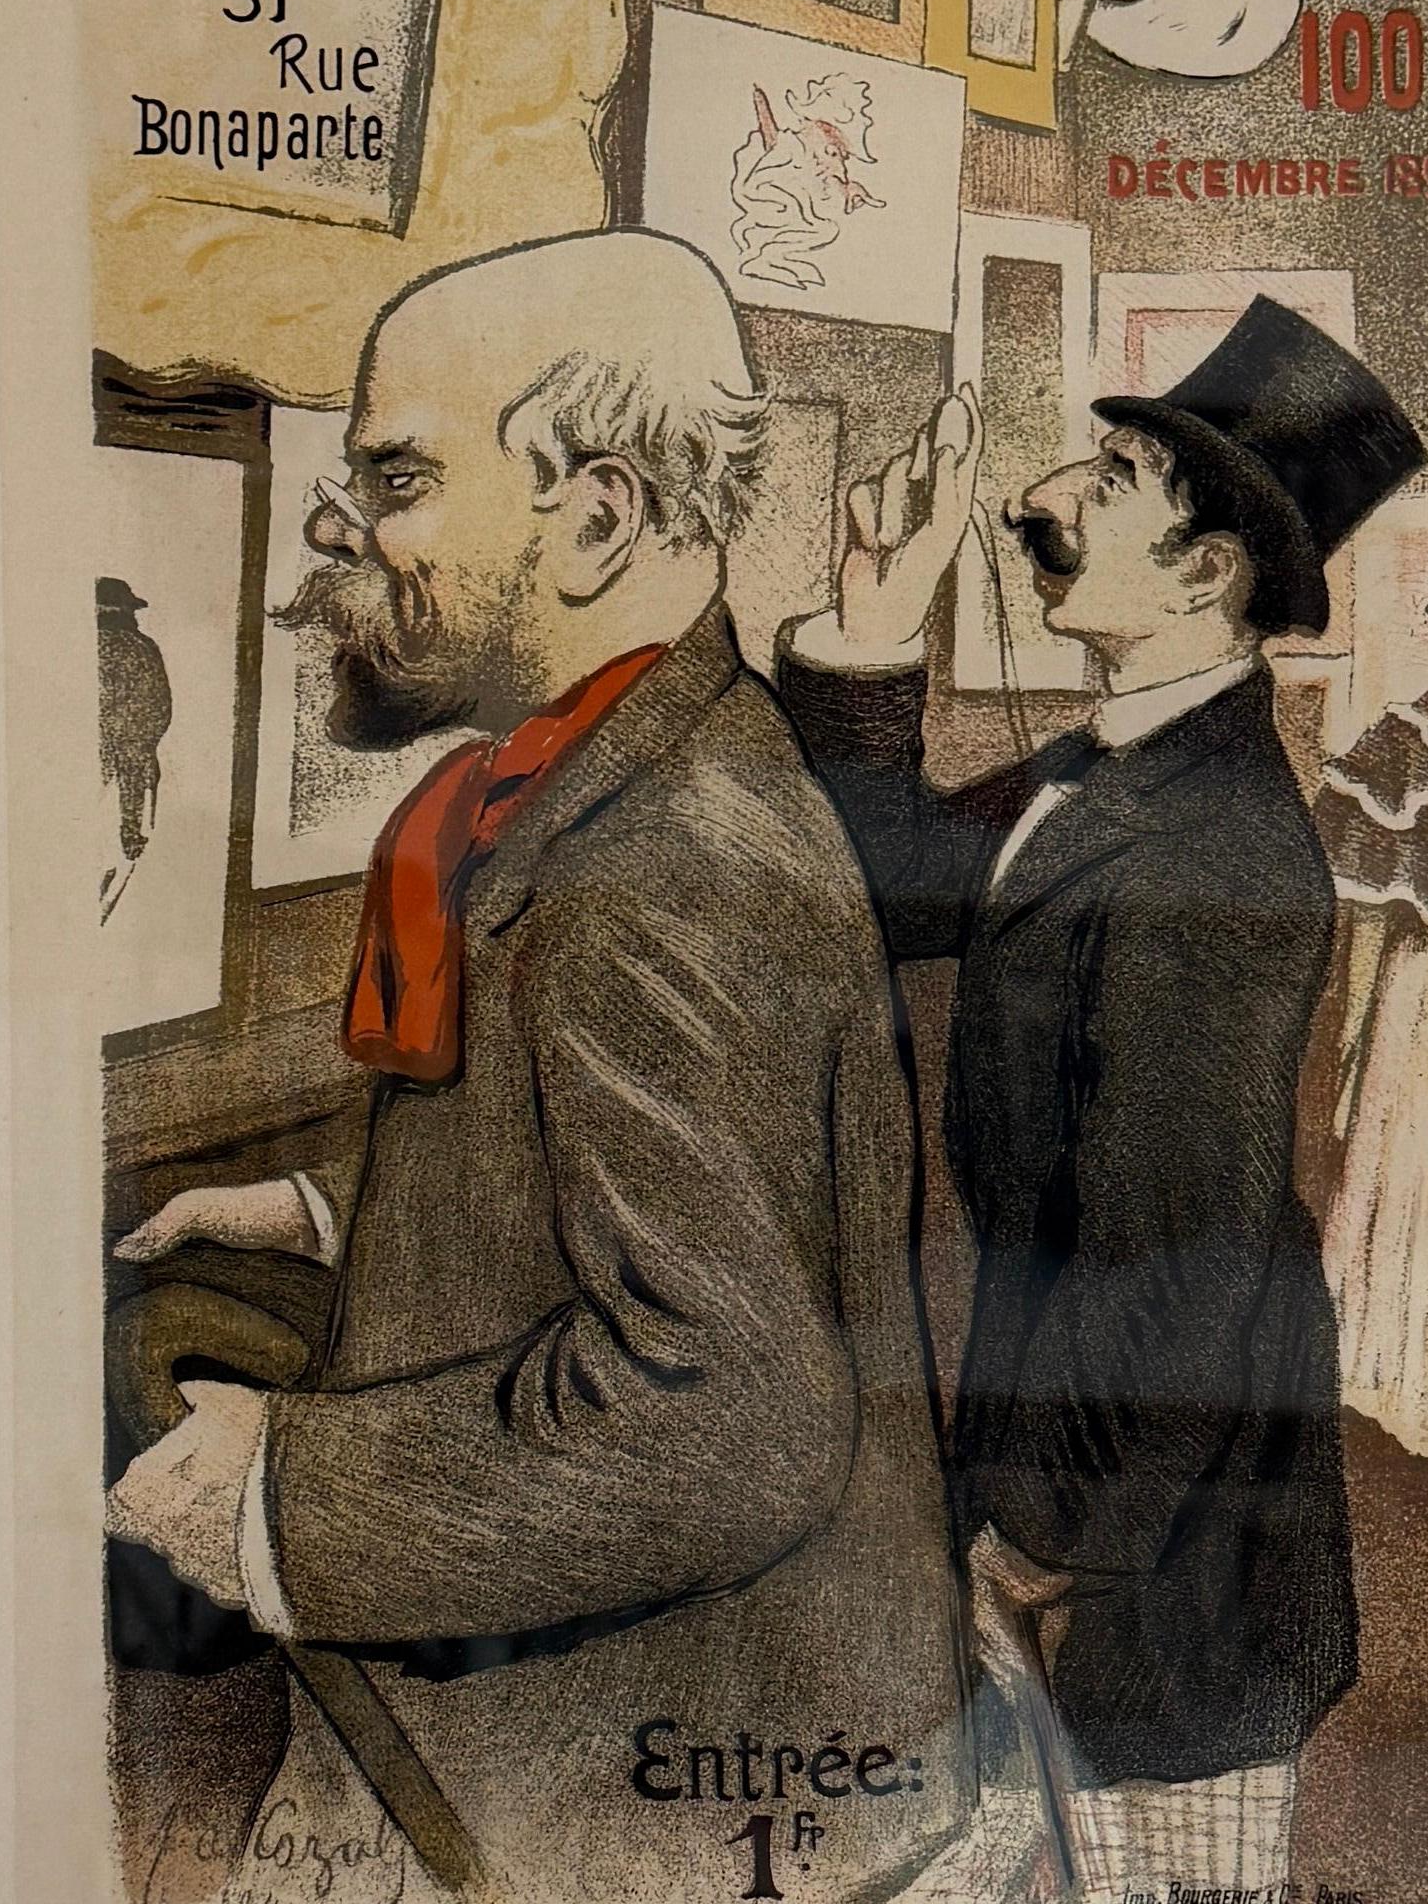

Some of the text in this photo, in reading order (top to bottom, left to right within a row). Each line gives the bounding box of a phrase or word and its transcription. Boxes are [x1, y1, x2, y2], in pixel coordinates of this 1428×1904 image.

[269, 33, 379, 94] Rue
[1300, 8, 1424, 114] 100
[132, 94, 384, 171] Bonaparte
[1106, 138, 1365, 202] DÉCEMBRE
[632, 1718, 925, 1802] Entrée:
